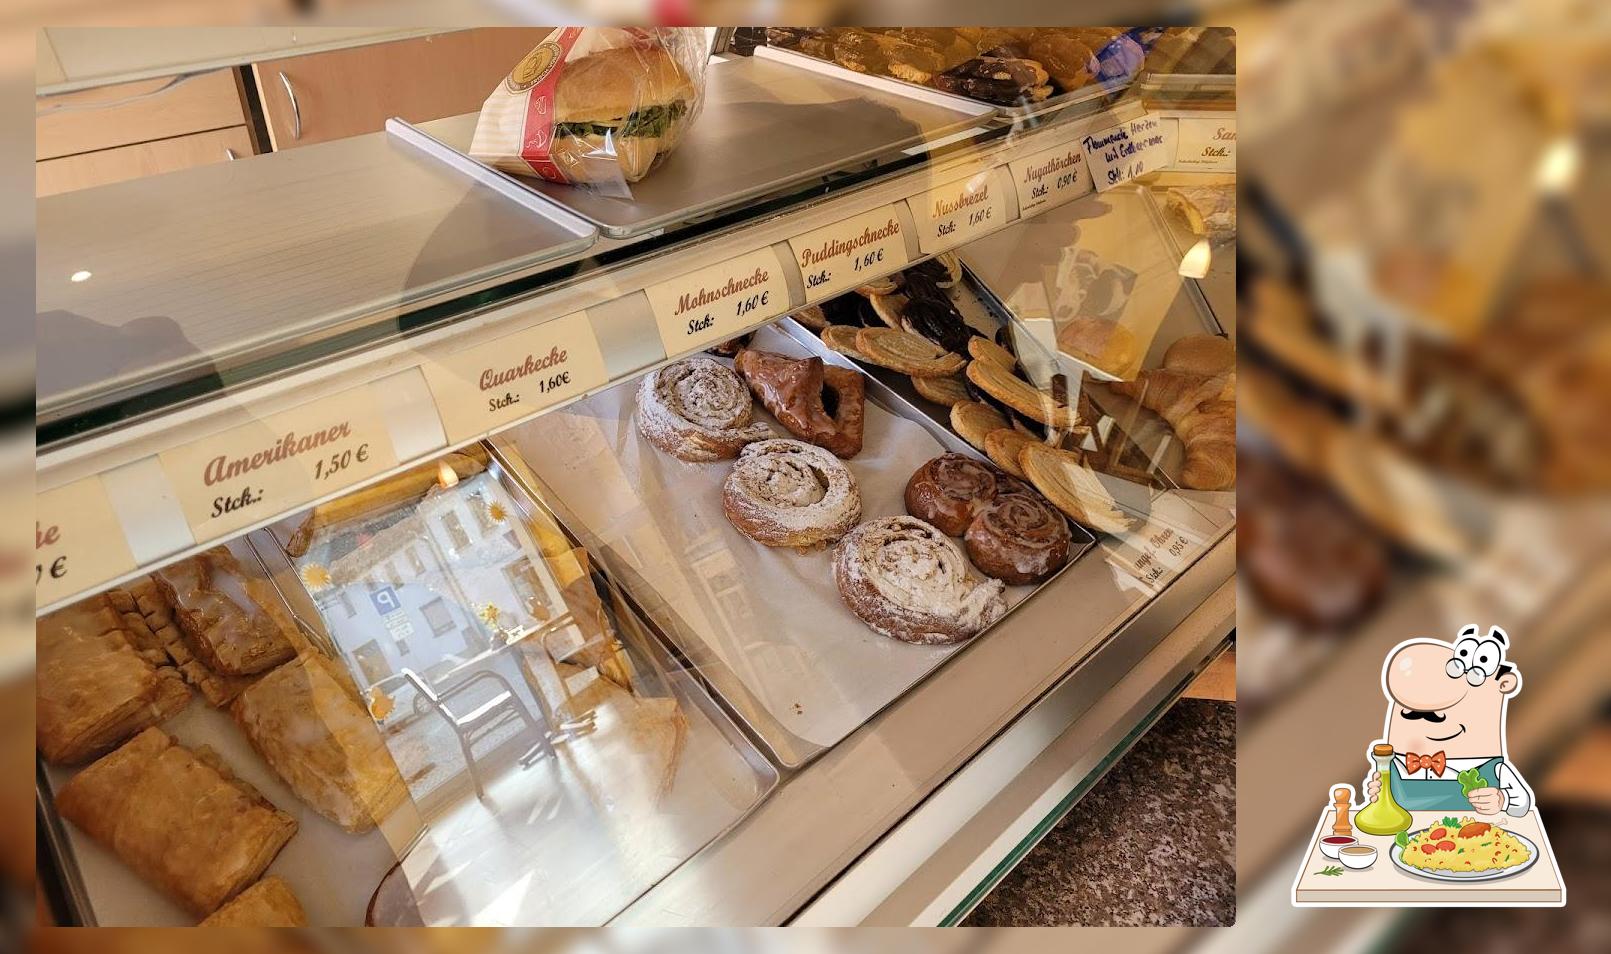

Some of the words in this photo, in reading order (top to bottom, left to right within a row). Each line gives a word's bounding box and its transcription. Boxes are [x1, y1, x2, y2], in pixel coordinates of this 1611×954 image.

[932, 184, 988, 218] Nussbrezel
[985, 206, 992, 219] €
[801, 218, 900, 268] Puddingschnecke
[877, 248, 884, 262] €
[674, 267, 770, 315] Mohnschnecke
[736, 294, 759, 317] 1,60
[761, 290, 770, 306] €
[479, 345, 568, 391] Quarkecke
[203, 420, 352, 487] Amerikaner
[314, 449, 352, 480] 1,50
[356, 443, 369, 463] €
[50, 555, 68, 579] €
